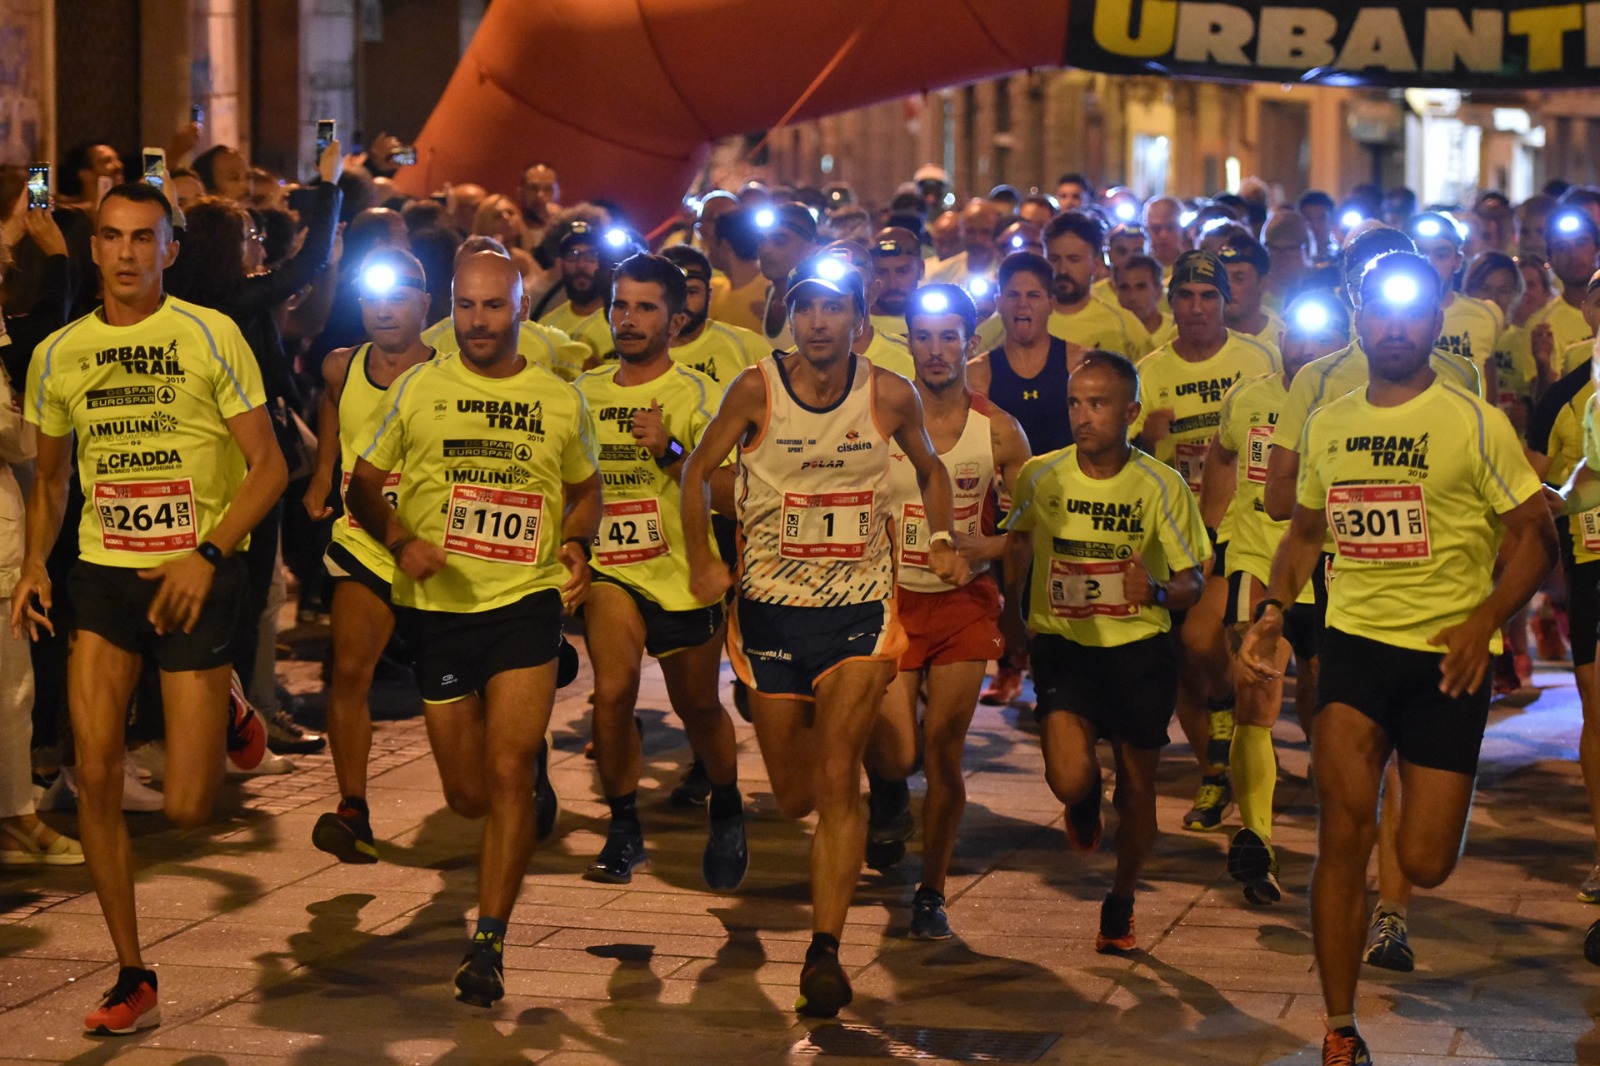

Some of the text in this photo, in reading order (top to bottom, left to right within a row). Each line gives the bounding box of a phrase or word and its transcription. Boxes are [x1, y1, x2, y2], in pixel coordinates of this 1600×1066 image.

[95, 346, 164, 367] URBAN
[121, 360, 185, 376] TRAIL
[166, 376, 186, 384] 2019
[1175, 377, 1232, 396] URBAN
[91, 396, 155, 408] EUROSPAR
[457, 399, 529, 417] URBAN
[96, 419, 160, 436] MULINI
[486, 413, 545, 435] TRAIL
[527, 433, 545, 443] 2019
[1346, 435, 1415, 452] URBAN
[108, 449, 182, 469] CFADDA
[448, 449, 512, 460] EUROSPAR
[1371, 451, 1430, 470] TRAIL
[801, 459, 845, 471] POLAR
[1408, 469, 1428, 479] 2019
[452, 469, 513, 484] MULINI
[113, 502, 175, 531] 264
[1067, 499, 1131, 518] URBAN
[474, 508, 522, 540] 110
[823, 512, 835, 537] 1
[1092, 516, 1145, 533] TRAIL
[1347, 508, 1401, 537] 301
[609, 521, 640, 546] 42
[1085, 580, 1101, 600] 3
